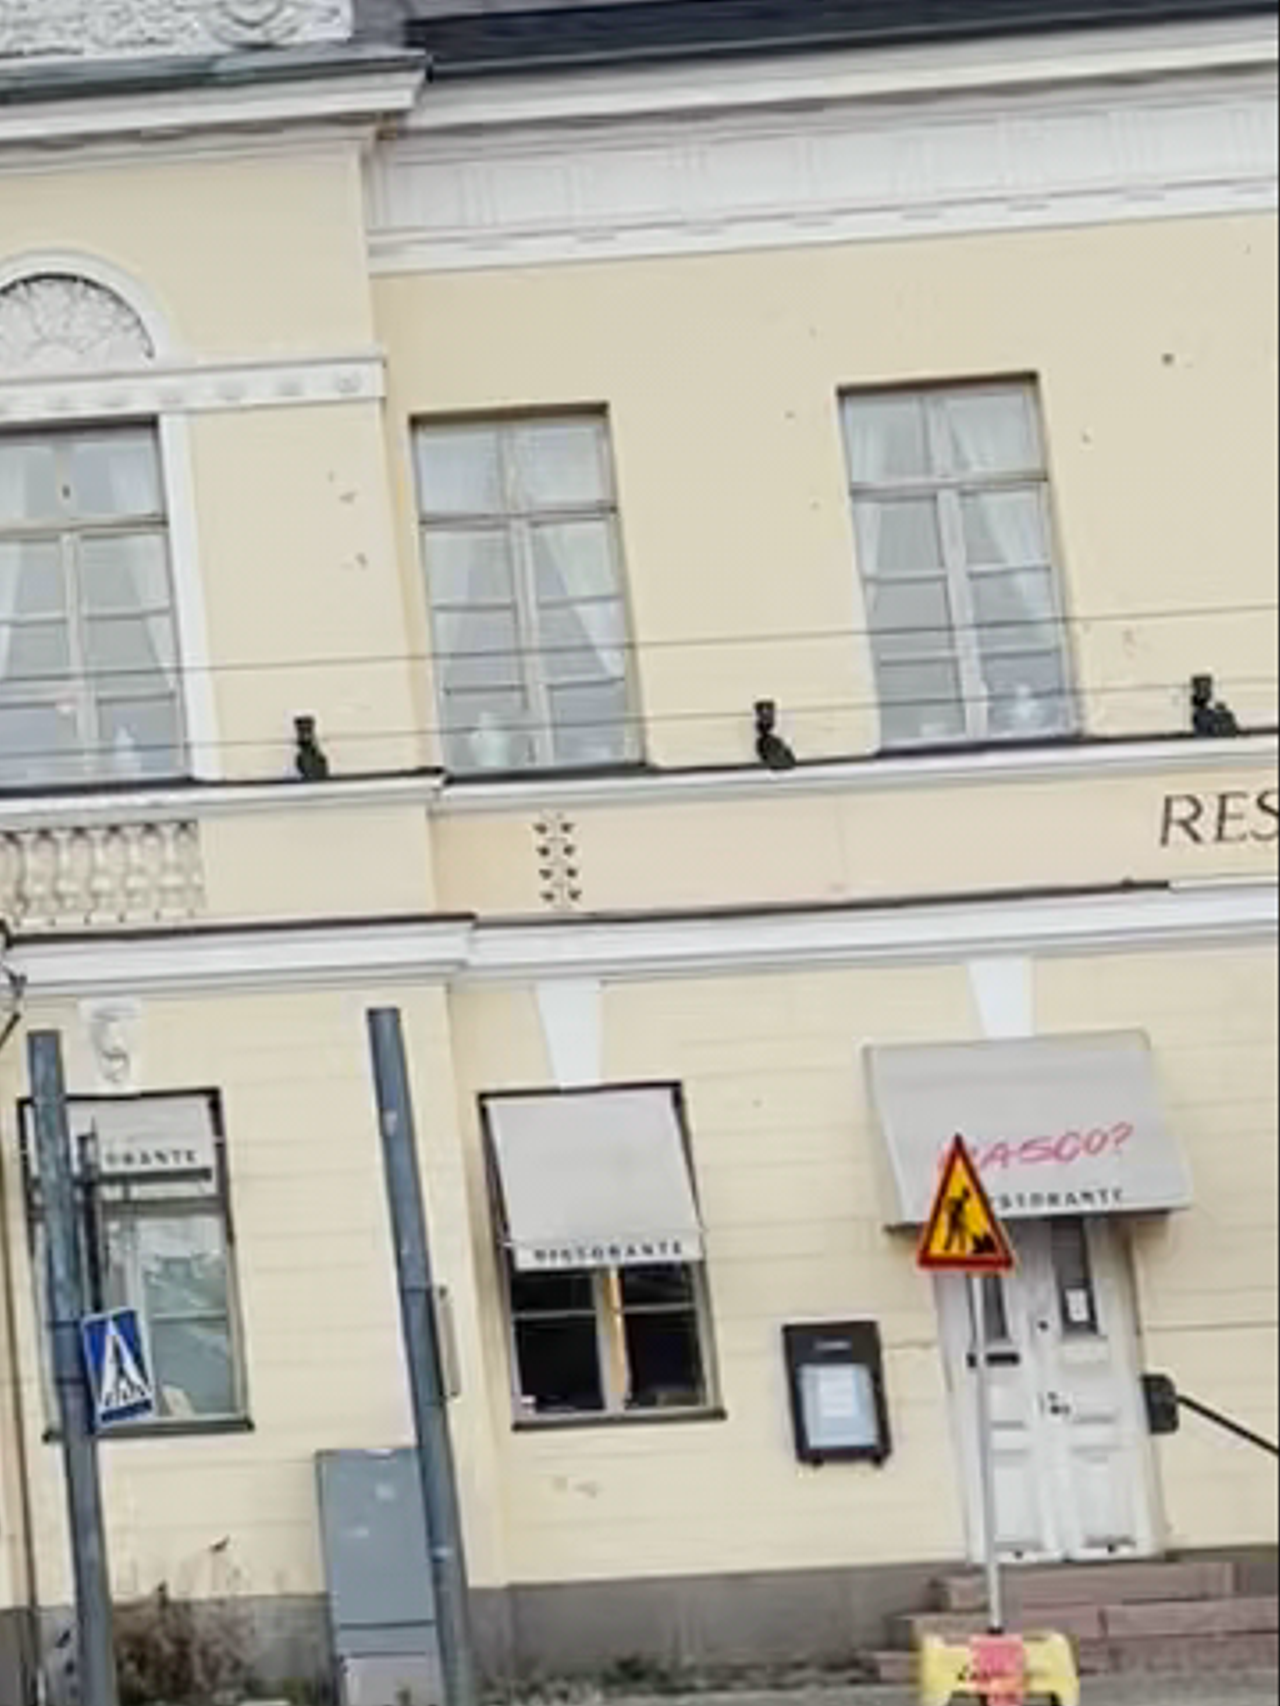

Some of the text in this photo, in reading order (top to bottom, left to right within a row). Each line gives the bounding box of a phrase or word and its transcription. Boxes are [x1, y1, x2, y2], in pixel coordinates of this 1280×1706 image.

[1159, 789, 1279, 848] RES
[970, 1121, 1134, 1169] ASCO?
[987, 1188, 1124, 1210] STORANTE
